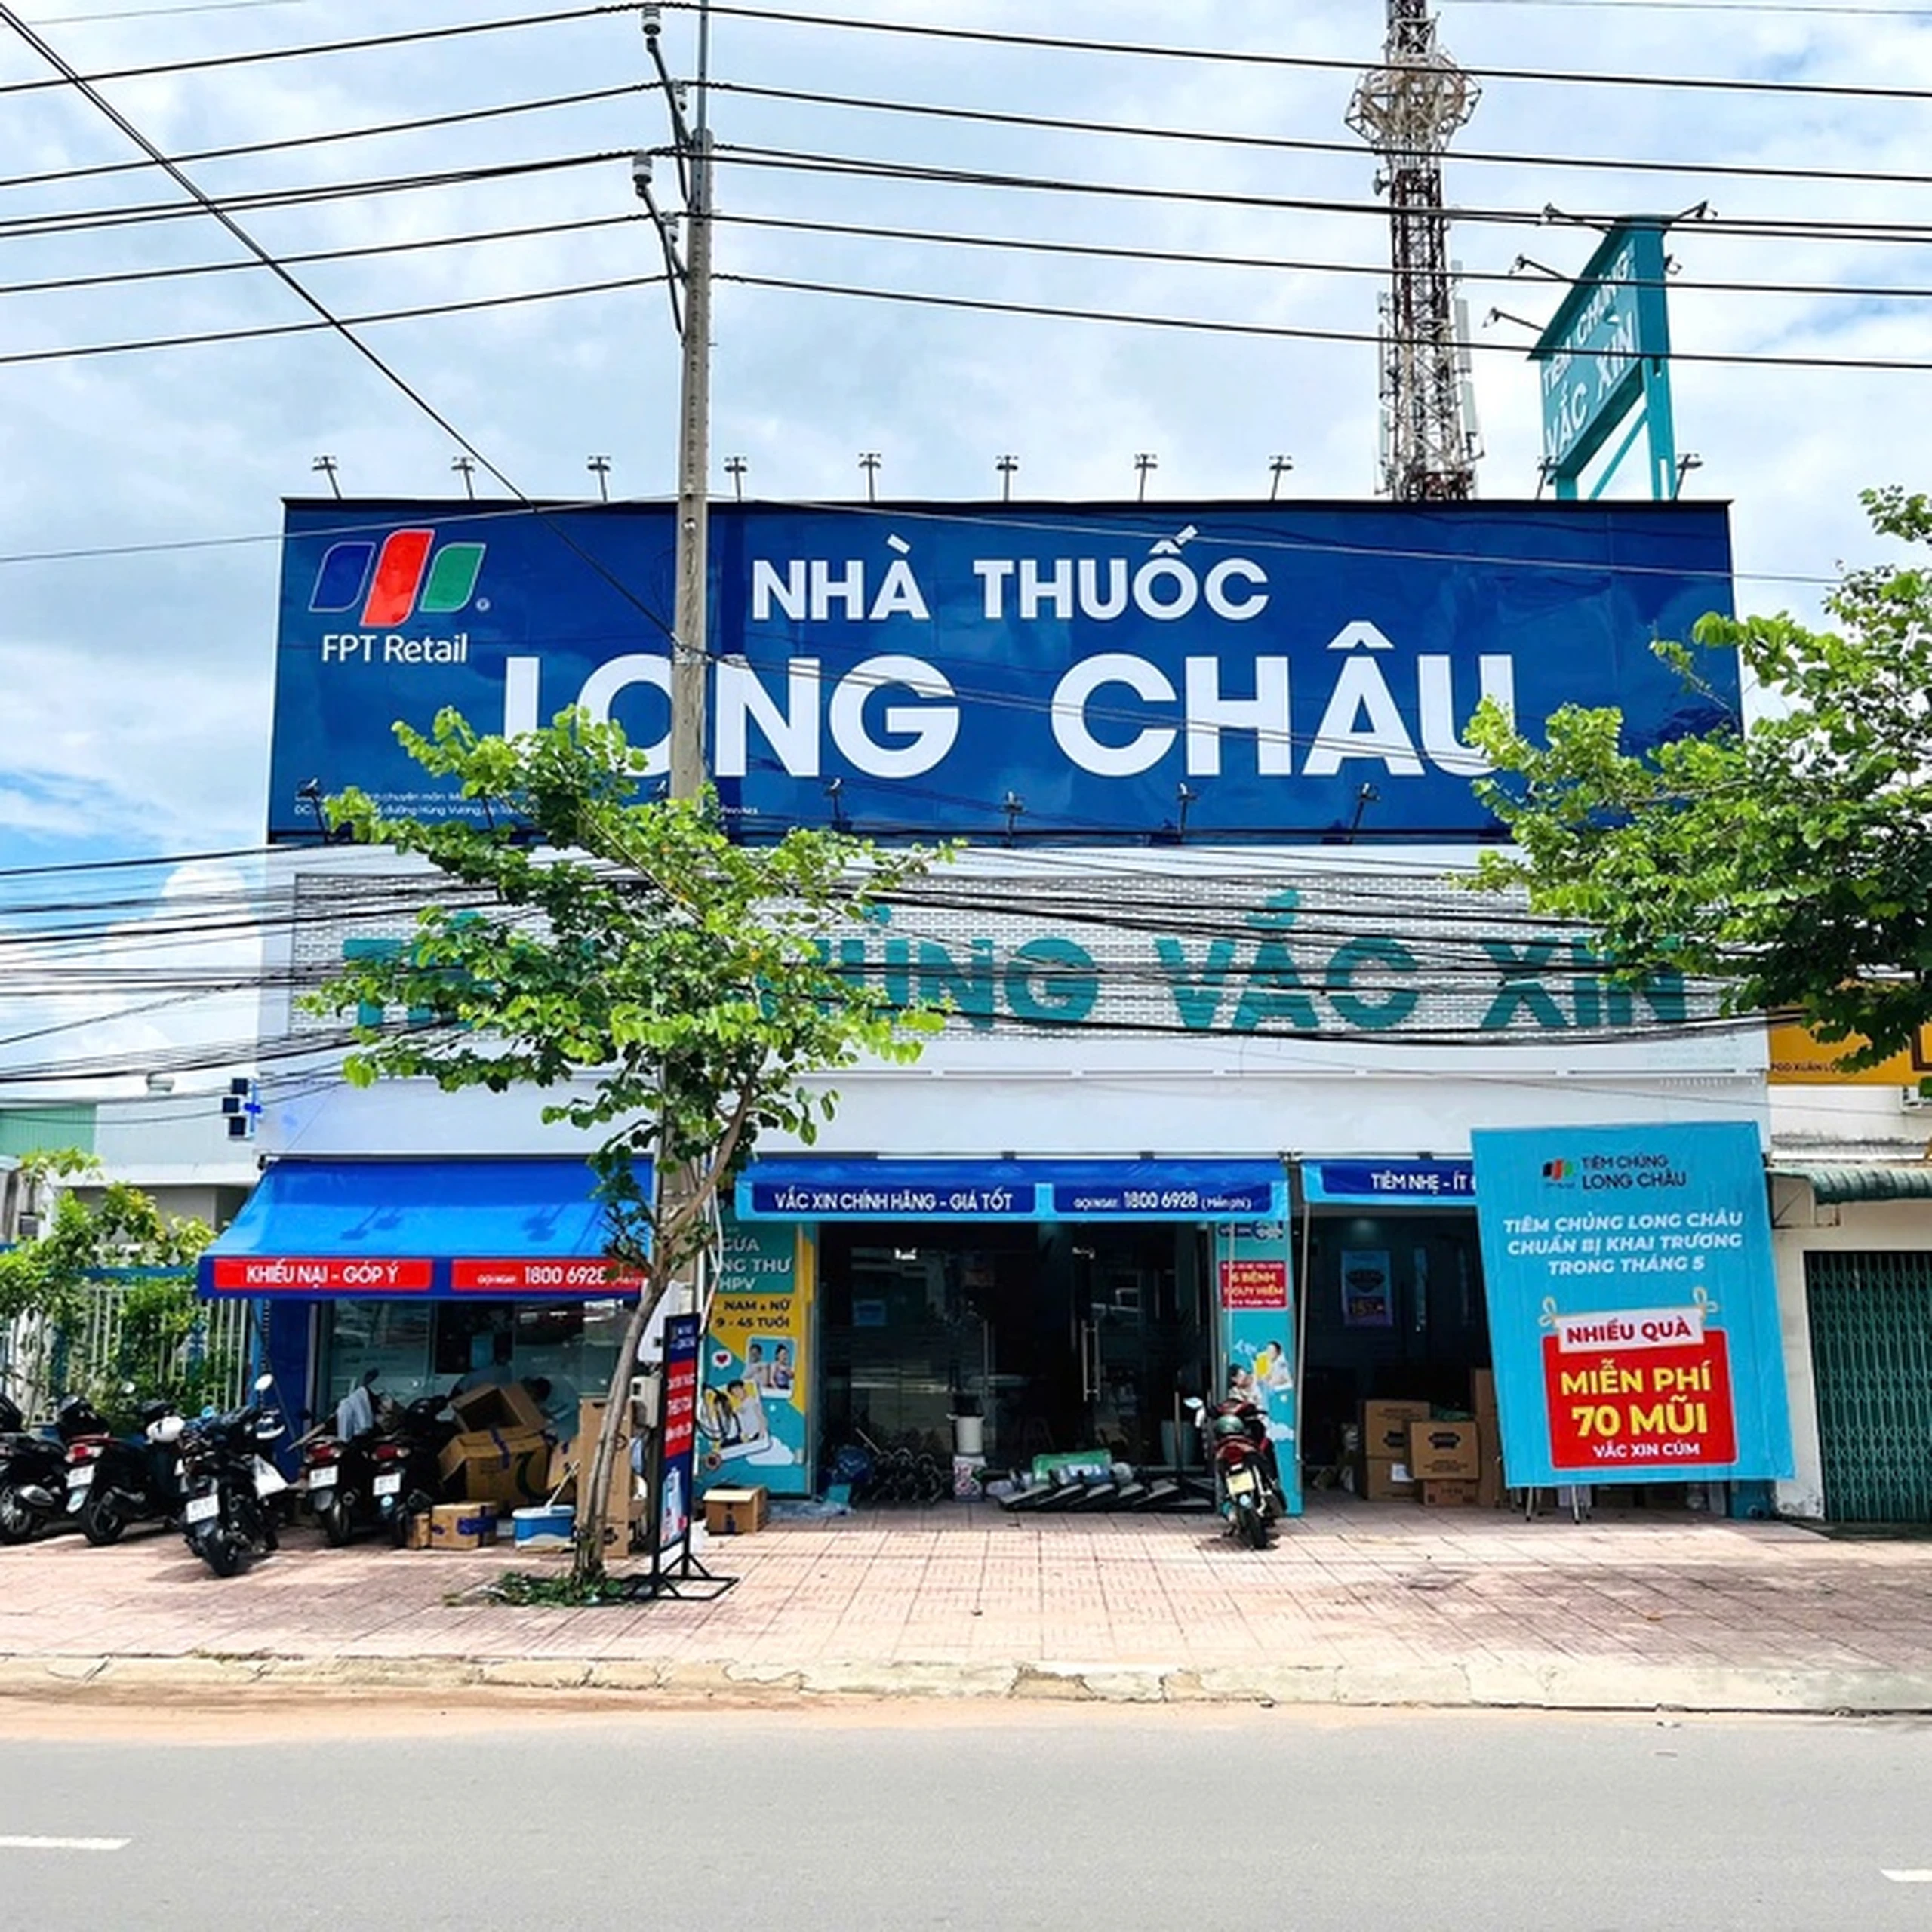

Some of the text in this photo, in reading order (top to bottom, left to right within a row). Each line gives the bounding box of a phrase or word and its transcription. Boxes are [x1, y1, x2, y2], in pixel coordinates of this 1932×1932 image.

[752, 525, 1270, 622] NHÀ THUỐC
[322, 632, 469, 663] FPT Retail
[1051, 620, 1516, 778] CHÂU
[1583, 1172, 1634, 1190] LONG
[1636, 1168, 1687, 1189] CHÂU
[774, 1186, 809, 1210] VẮC
[811, 1192, 838, 1210] XIN
[840, 1189, 889, 1210] CHÍNH
[949, 1189, 978, 1211] GIÁ
[981, 1186, 1014, 1211] TỐT
[1124, 1191, 1158, 1209] 1800
[1161, 1191, 1198, 1209] 6928
[1503, 1214, 1550, 1233] TIÊM
[1628, 1213, 1682, 1231] LONG
[1686, 1208, 1743, 1228] CHÂU
[1581, 1238, 1601, 1257] BỊ
[1606, 1237, 1655, 1254] KHAI
[1659, 1232, 1743, 1251] TRƯƠNG
[246, 1257, 295, 1284] KHIẾU
[297, 1264, 329, 1290] NẠI
[343, 1260, 384, 1284] GÓP
[386, 1260, 399, 1284] Ý
[524, 1266, 562, 1284] 1800
[566, 1266, 608, 1284] 6928
[751, 1255, 792, 1273] THƯ
[1548, 1255, 1706, 1276] TRONG THÁNG 5
[718, 1276, 758, 1291] HPV
[724, 1300, 757, 1312] NAM
[715, 1317, 725, 1328] 9
[737, 1317, 754, 1328] 45
[1641, 1315, 1692, 1342] QUÀ
[1559, 1358, 1712, 1396] MIỄN PHÍ
[1571, 1394, 1709, 1438] 70 MŨI
[1592, 1438, 1701, 1459] VẮC XIN CÚM
